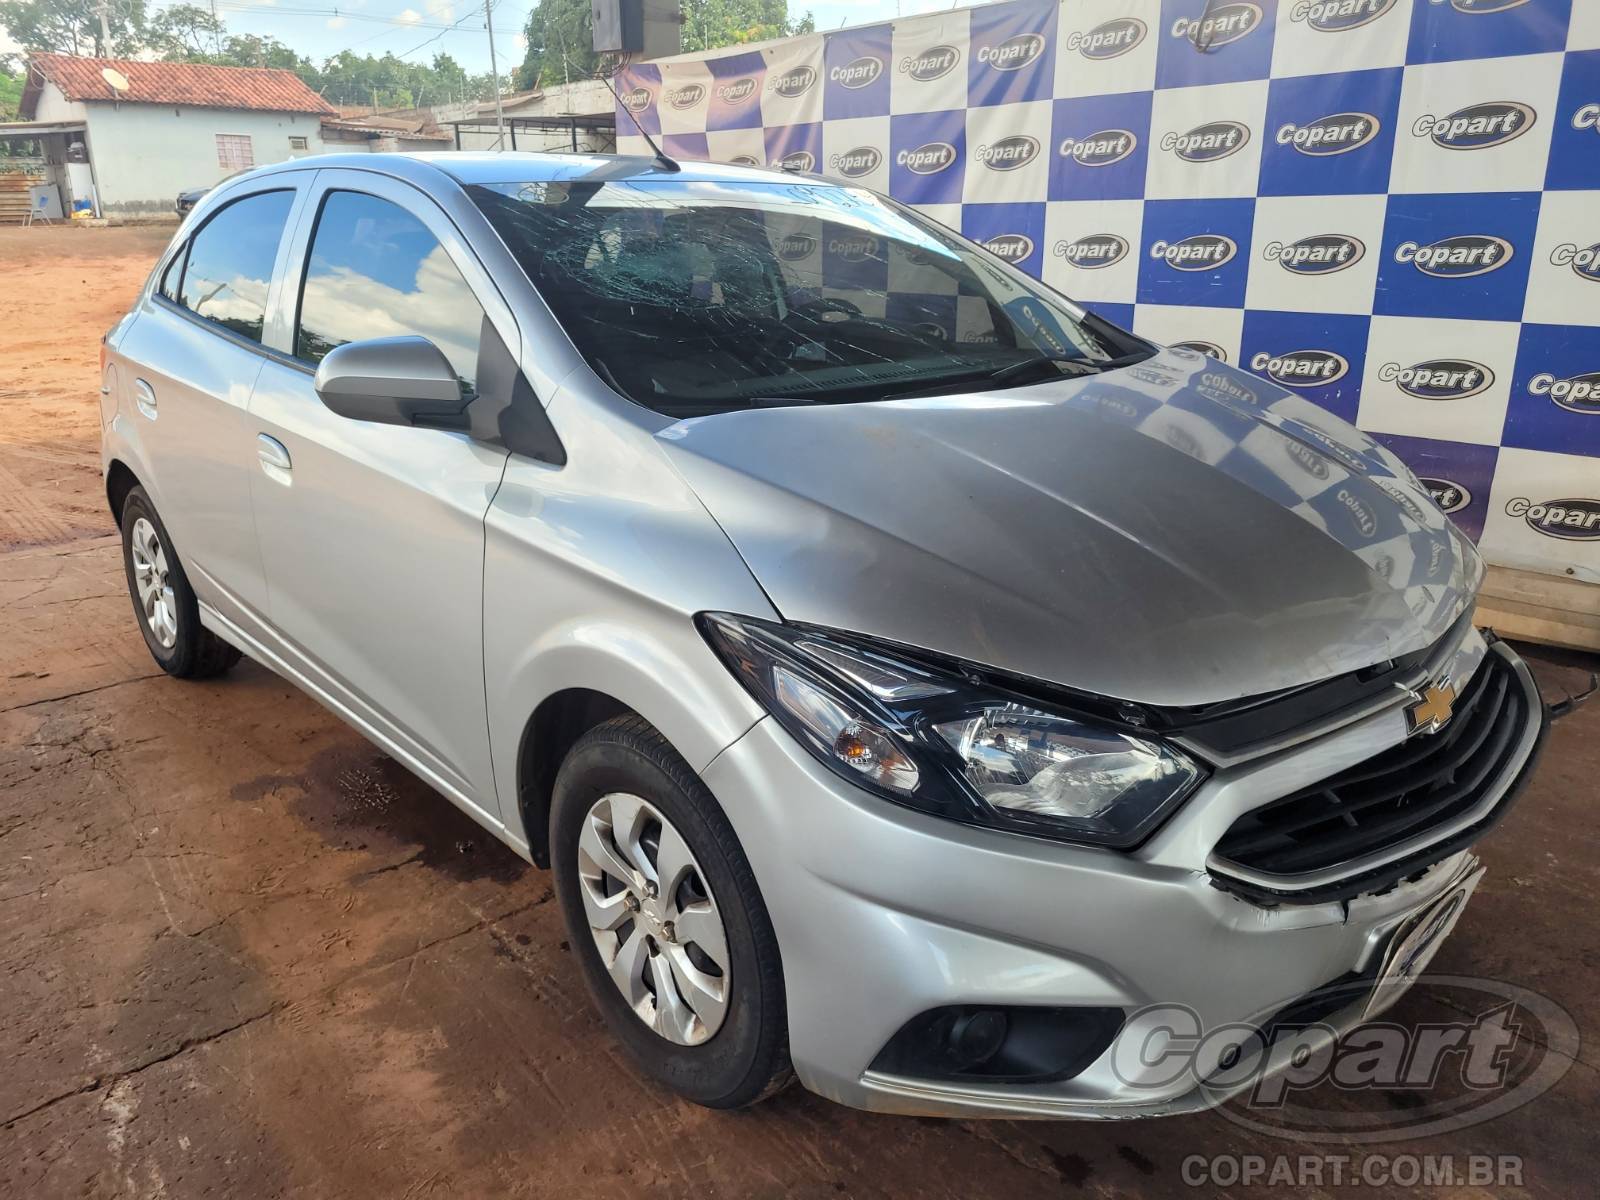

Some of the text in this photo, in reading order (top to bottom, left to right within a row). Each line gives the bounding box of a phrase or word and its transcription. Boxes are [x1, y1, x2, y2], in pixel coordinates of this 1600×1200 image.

[1171, 10, 1252, 39] Copart
[978, 38, 1038, 63] Copart
[1067, 25, 1136, 52] Copart
[830, 63, 875, 84] Copart
[899, 53, 951, 75] Copart
[716, 82, 753, 98] Copart
[768, 72, 812, 93] Copart
[1276, 119, 1368, 147] Copart
[1412, 104, 1520, 141] Copart
[1060, 133, 1129, 158] Copart
[1160, 126, 1239, 153] Copart
[830, 153, 875, 171] Copart
[897, 146, 950, 168] Copart
[975, 142, 1033, 163] Copart
[1053, 240, 1121, 262] Copart
[1151, 240, 1226, 264] Copart
[1263, 241, 1354, 266] Copart
[1394, 242, 1501, 268] Copart
[1251, 352, 1339, 379] Copart
[1378, 362, 1480, 391] Copart
[1505, 497, 1600, 530] Copar
